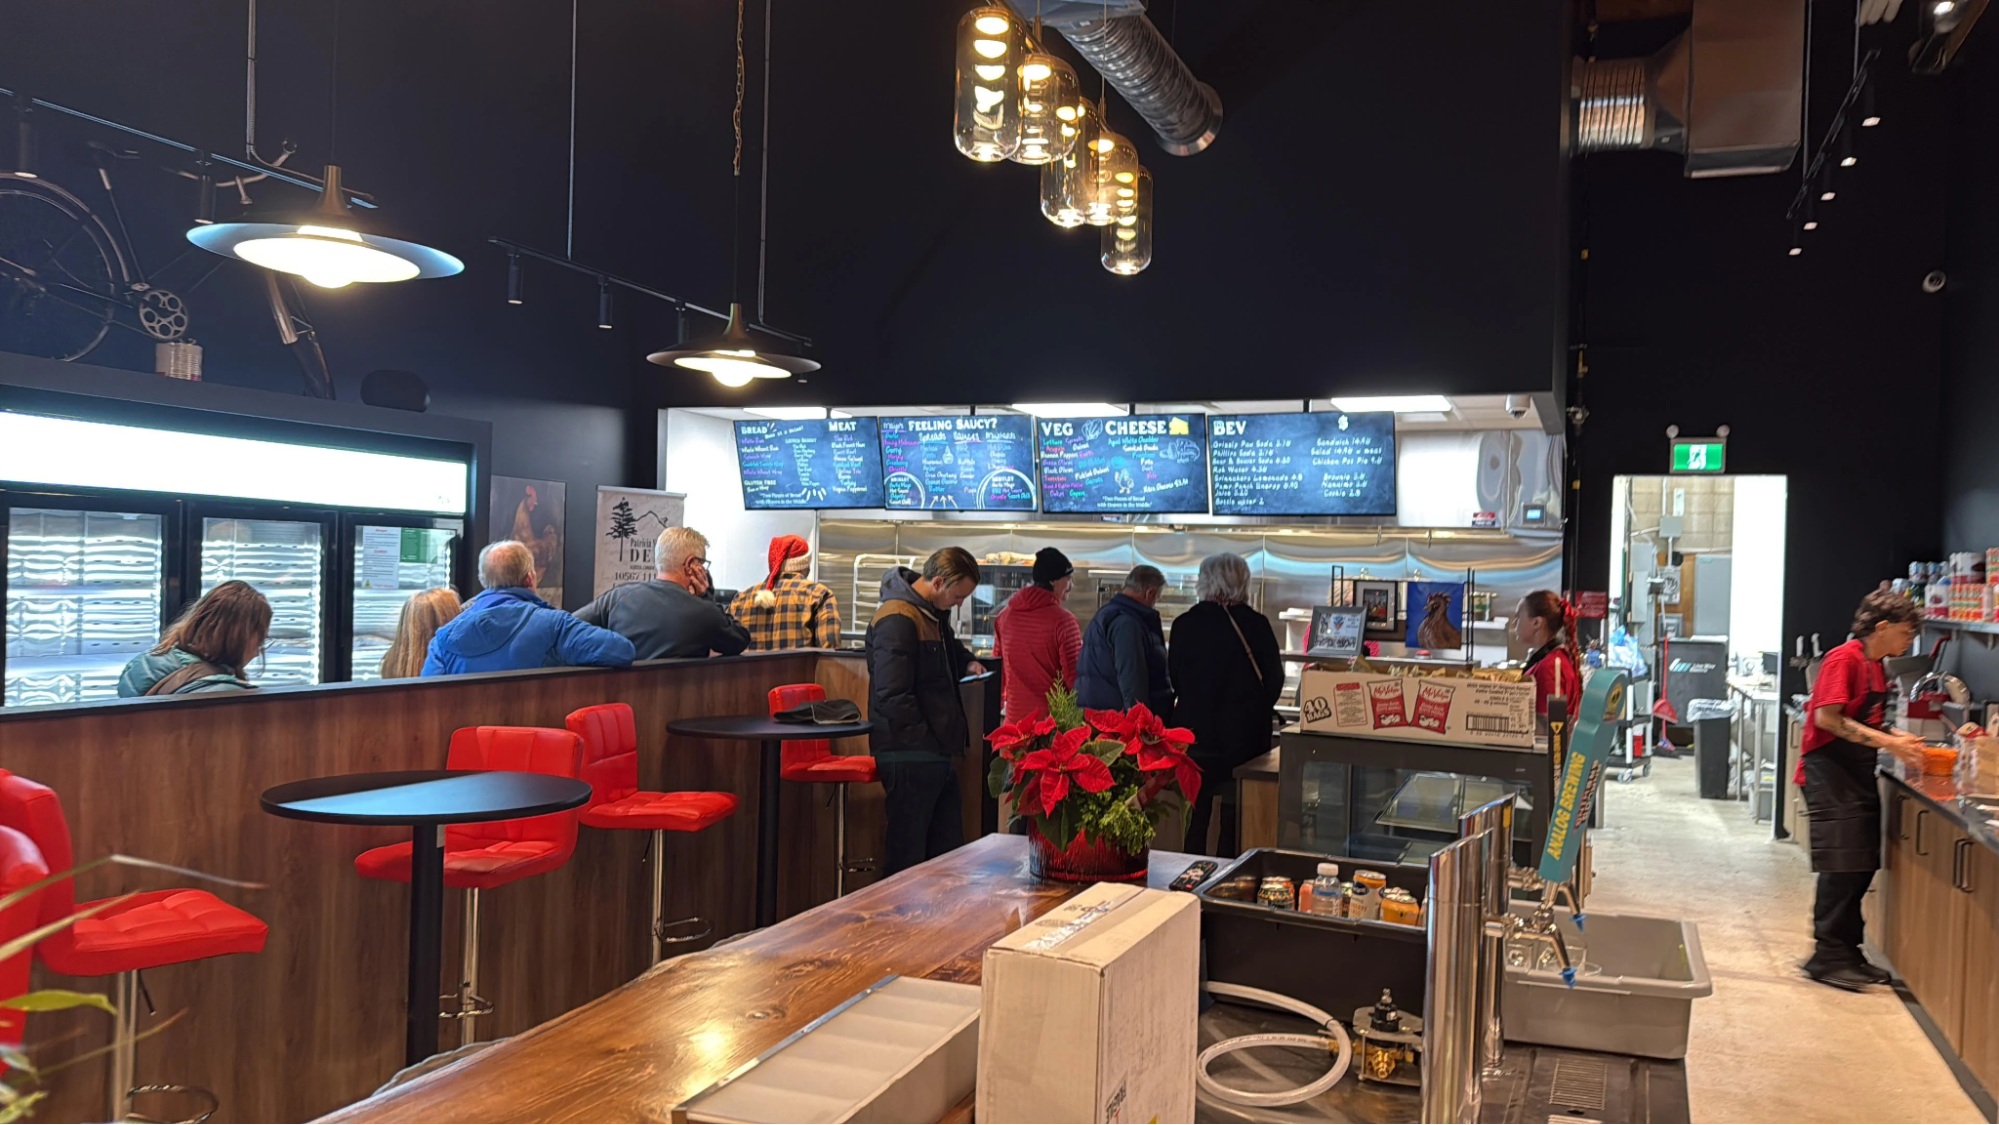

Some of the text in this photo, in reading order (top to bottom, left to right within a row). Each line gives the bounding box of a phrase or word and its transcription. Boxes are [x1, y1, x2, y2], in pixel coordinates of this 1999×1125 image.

[829, 422, 856, 431] MEAT
[908, 420, 953, 431] FEELING
[955, 418, 998, 430] SAUCY?
[1040, 422, 1073, 436] VEG
[1105, 420, 1167, 435] CHEESE
[1213, 420, 1247, 436] BEV
[741, 426, 768, 434] BREAD
[1256, 440, 1273, 448] Soda
[1317, 438, 1349, 446] Sandwich
[1060, 451, 1078, 459] Peppers
[1239, 448, 1255, 456] Soda
[1311, 447, 1331, 456] Salad
[1313, 458, 1339, 466] Chicken
[1342, 457, 1354, 465] Pot
[1357, 457, 1368, 465] Pie
[1321, 480, 1353, 488] Nanaimo
[1324, 489, 1346, 497] Cookie
[1304, 696, 1328, 713] 40
[1306, 708, 1332, 722] BAGS
[1547, 751, 1586, 860] ANALOG BREWING
